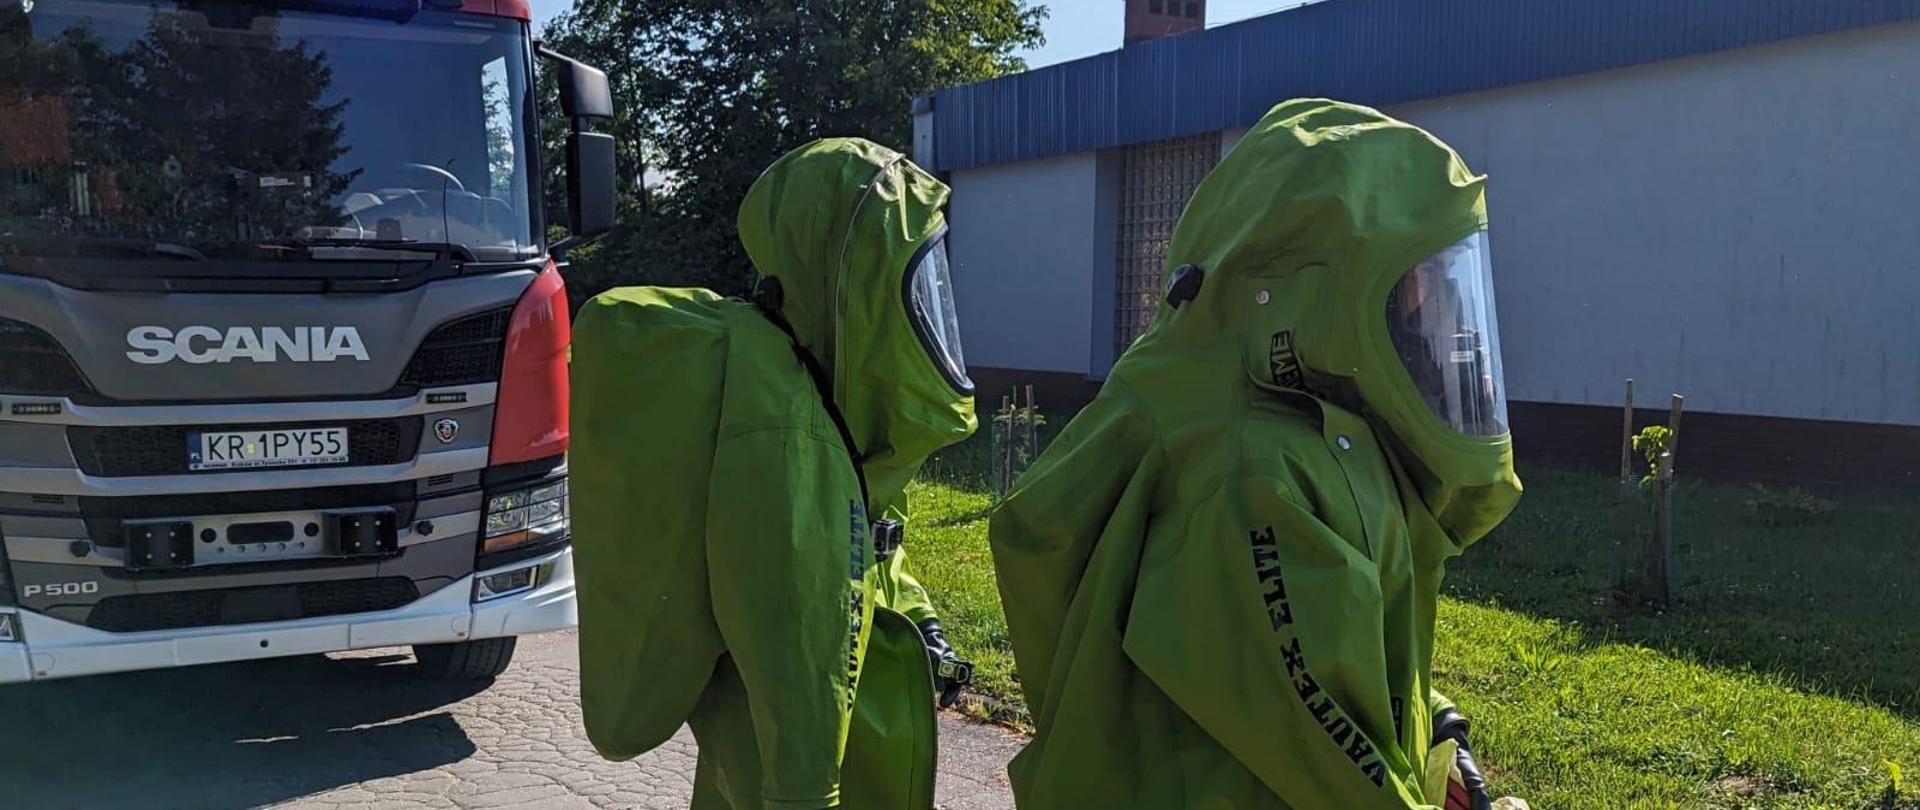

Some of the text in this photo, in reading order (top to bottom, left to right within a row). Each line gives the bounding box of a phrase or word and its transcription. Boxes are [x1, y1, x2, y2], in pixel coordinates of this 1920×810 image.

[126, 325, 370, 364] SCANIA
[208, 430, 341, 460] KR 1PY55
[850, 499, 865, 581] ELITE
[23, 580, 98, 598] P 500
[1250, 525, 1388, 789] VAUTEX ELITE
